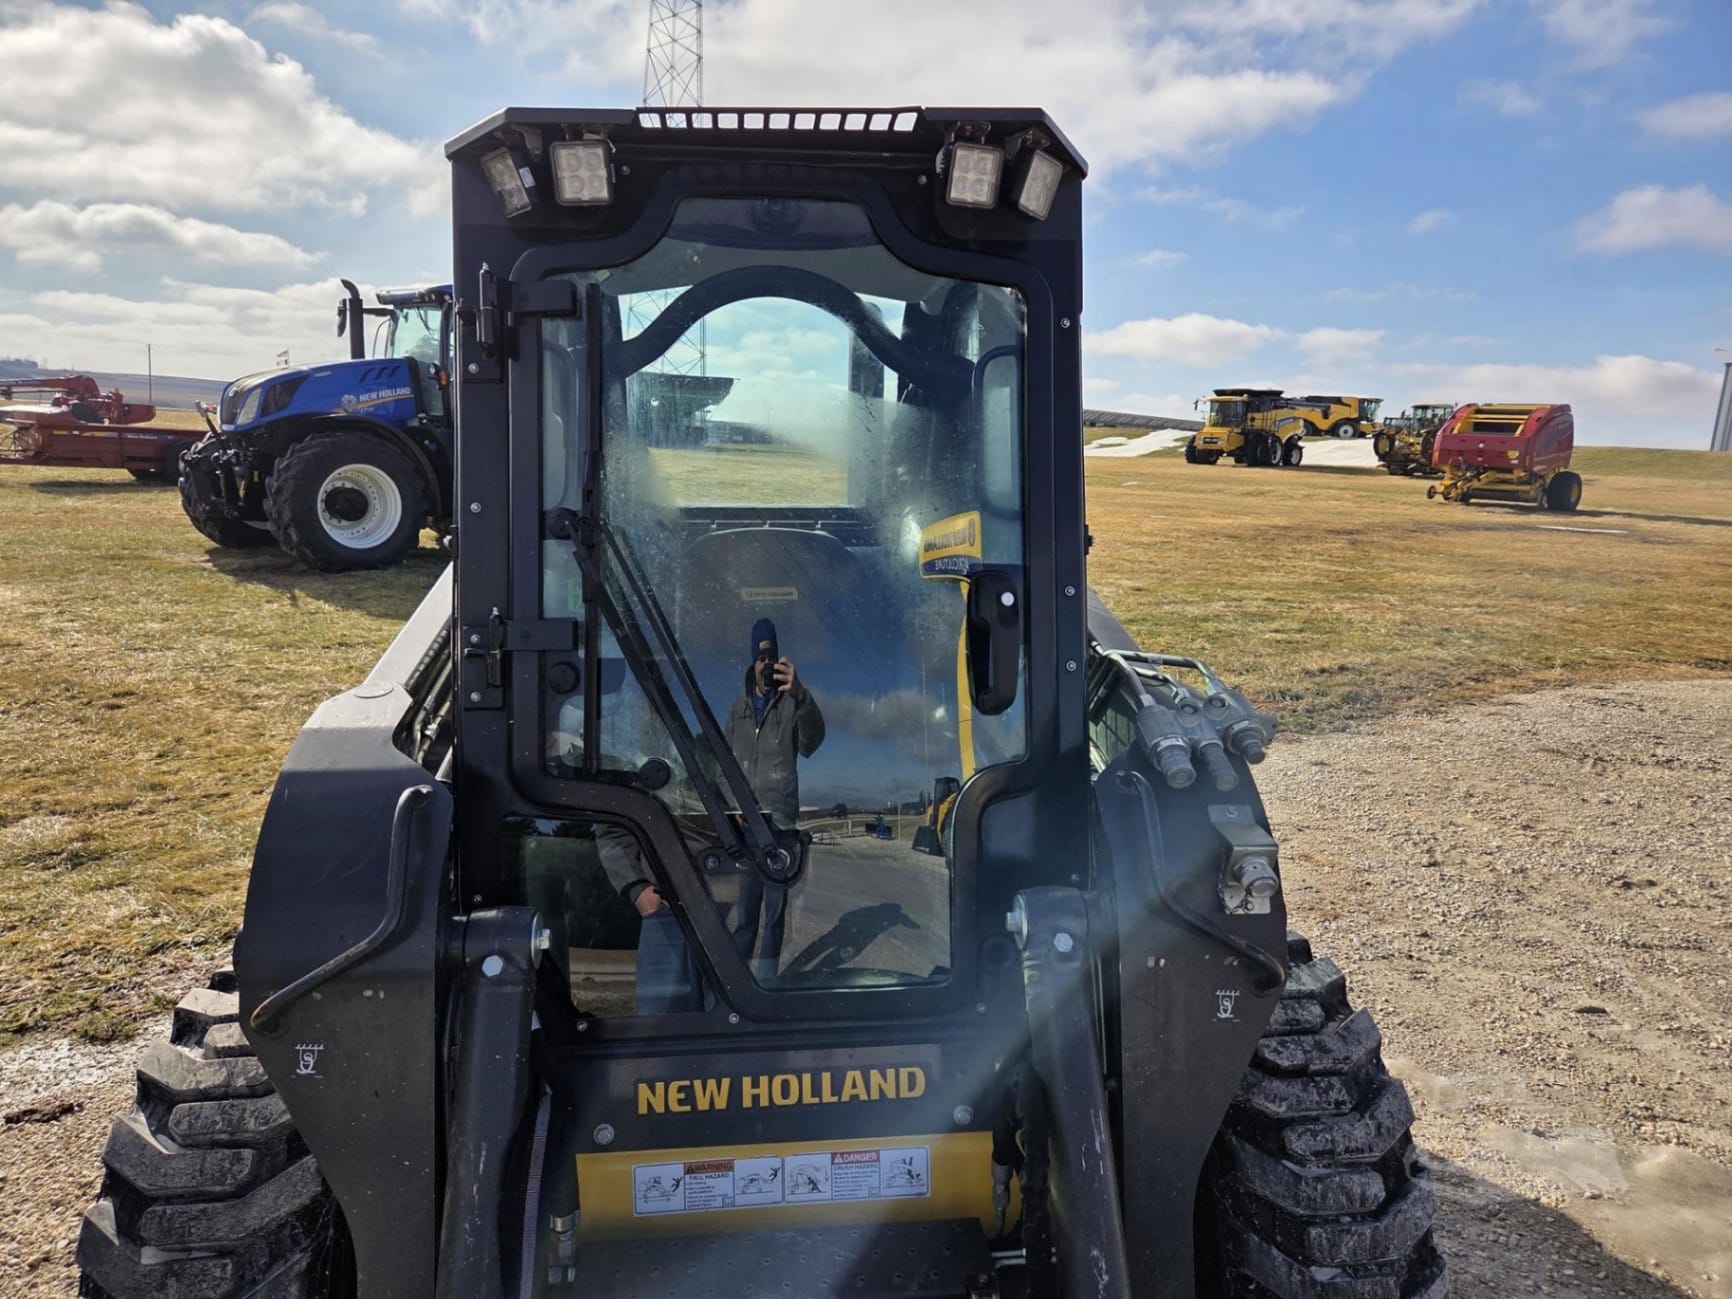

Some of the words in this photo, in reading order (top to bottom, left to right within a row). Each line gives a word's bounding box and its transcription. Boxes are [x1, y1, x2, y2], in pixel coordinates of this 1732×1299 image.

[359, 391, 378, 402] NEW
[378, 387, 411, 399] HOLLAND
[637, 1077, 731, 1115] NEW
[742, 1066, 926, 1108] HOLLAND
[843, 1152, 877, 1162] DANGER
[694, 1162, 732, 1172] WARNING
